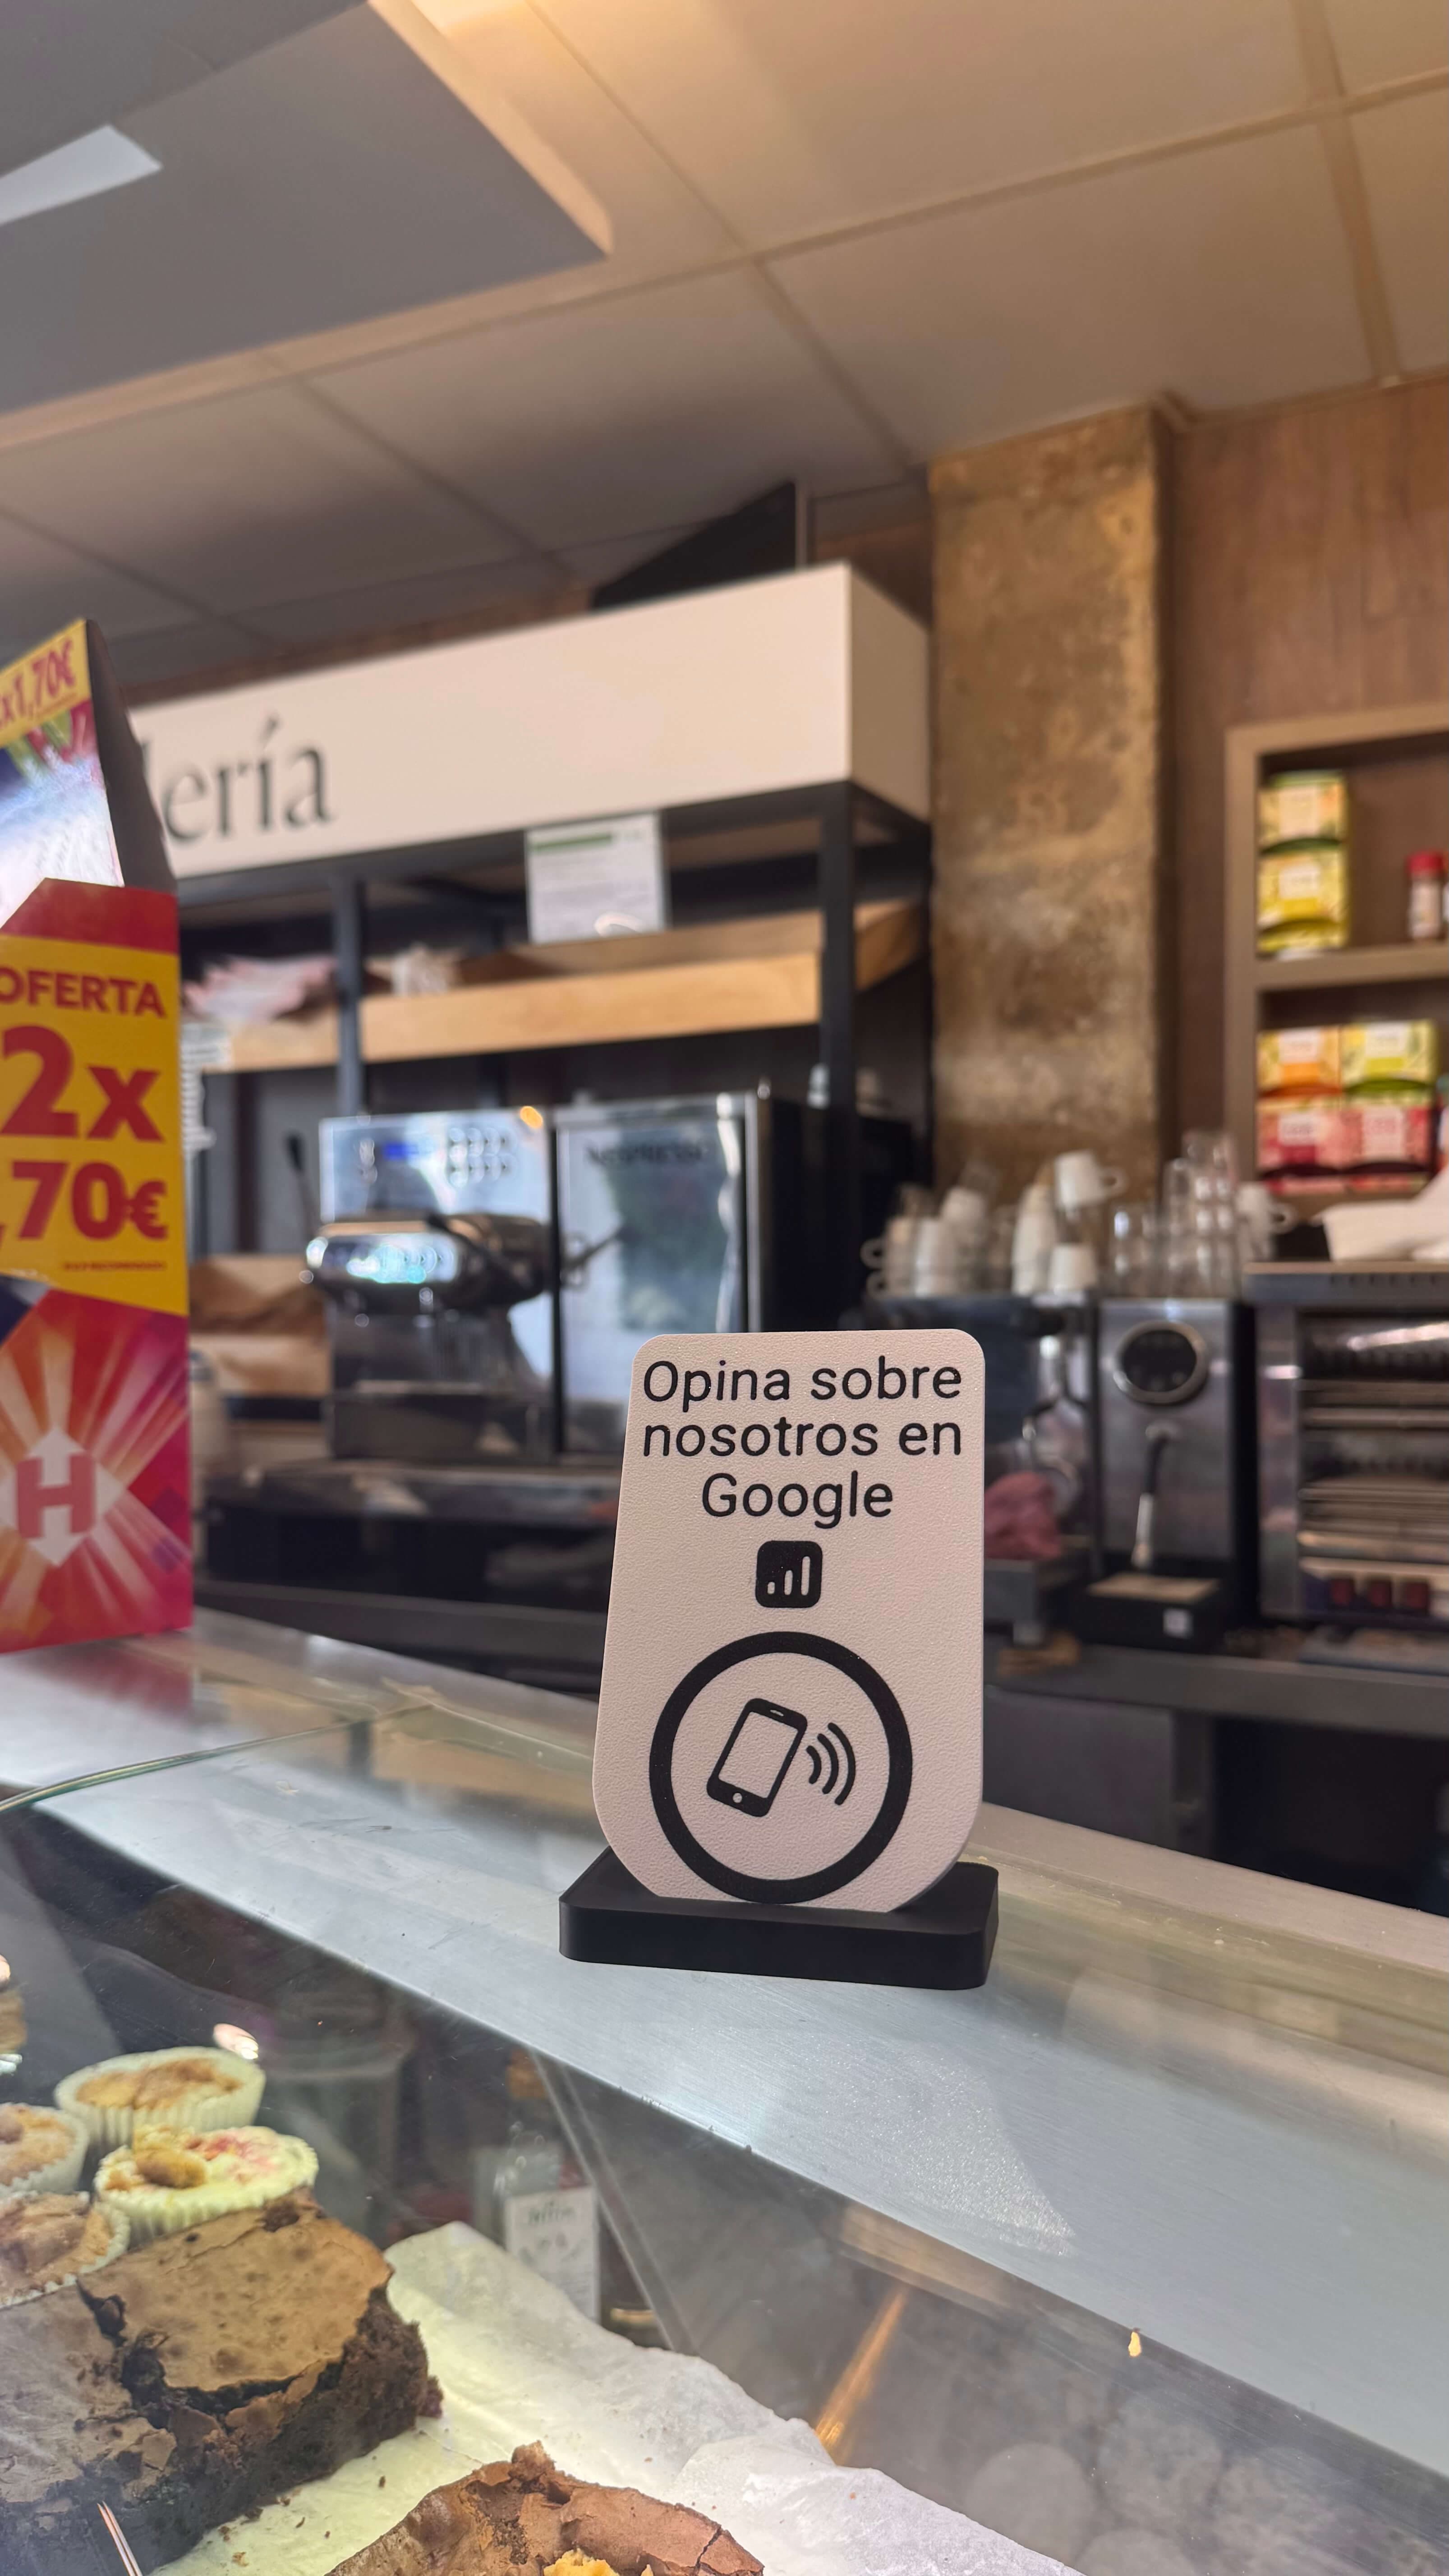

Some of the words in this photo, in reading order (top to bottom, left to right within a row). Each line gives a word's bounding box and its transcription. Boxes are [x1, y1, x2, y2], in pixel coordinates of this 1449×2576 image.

[140, 716, 333, 844] ería
[0, 965, 166, 1018] OFERTA
[0, 1024, 165, 1142] 2x
[644, 1360, 790, 1412] Opina
[810, 1355, 961, 1401] sobre
[643, 1417, 878, 1457] nosotros
[898, 1422, 961, 1456] en
[702, 1470, 893, 1529] Google
